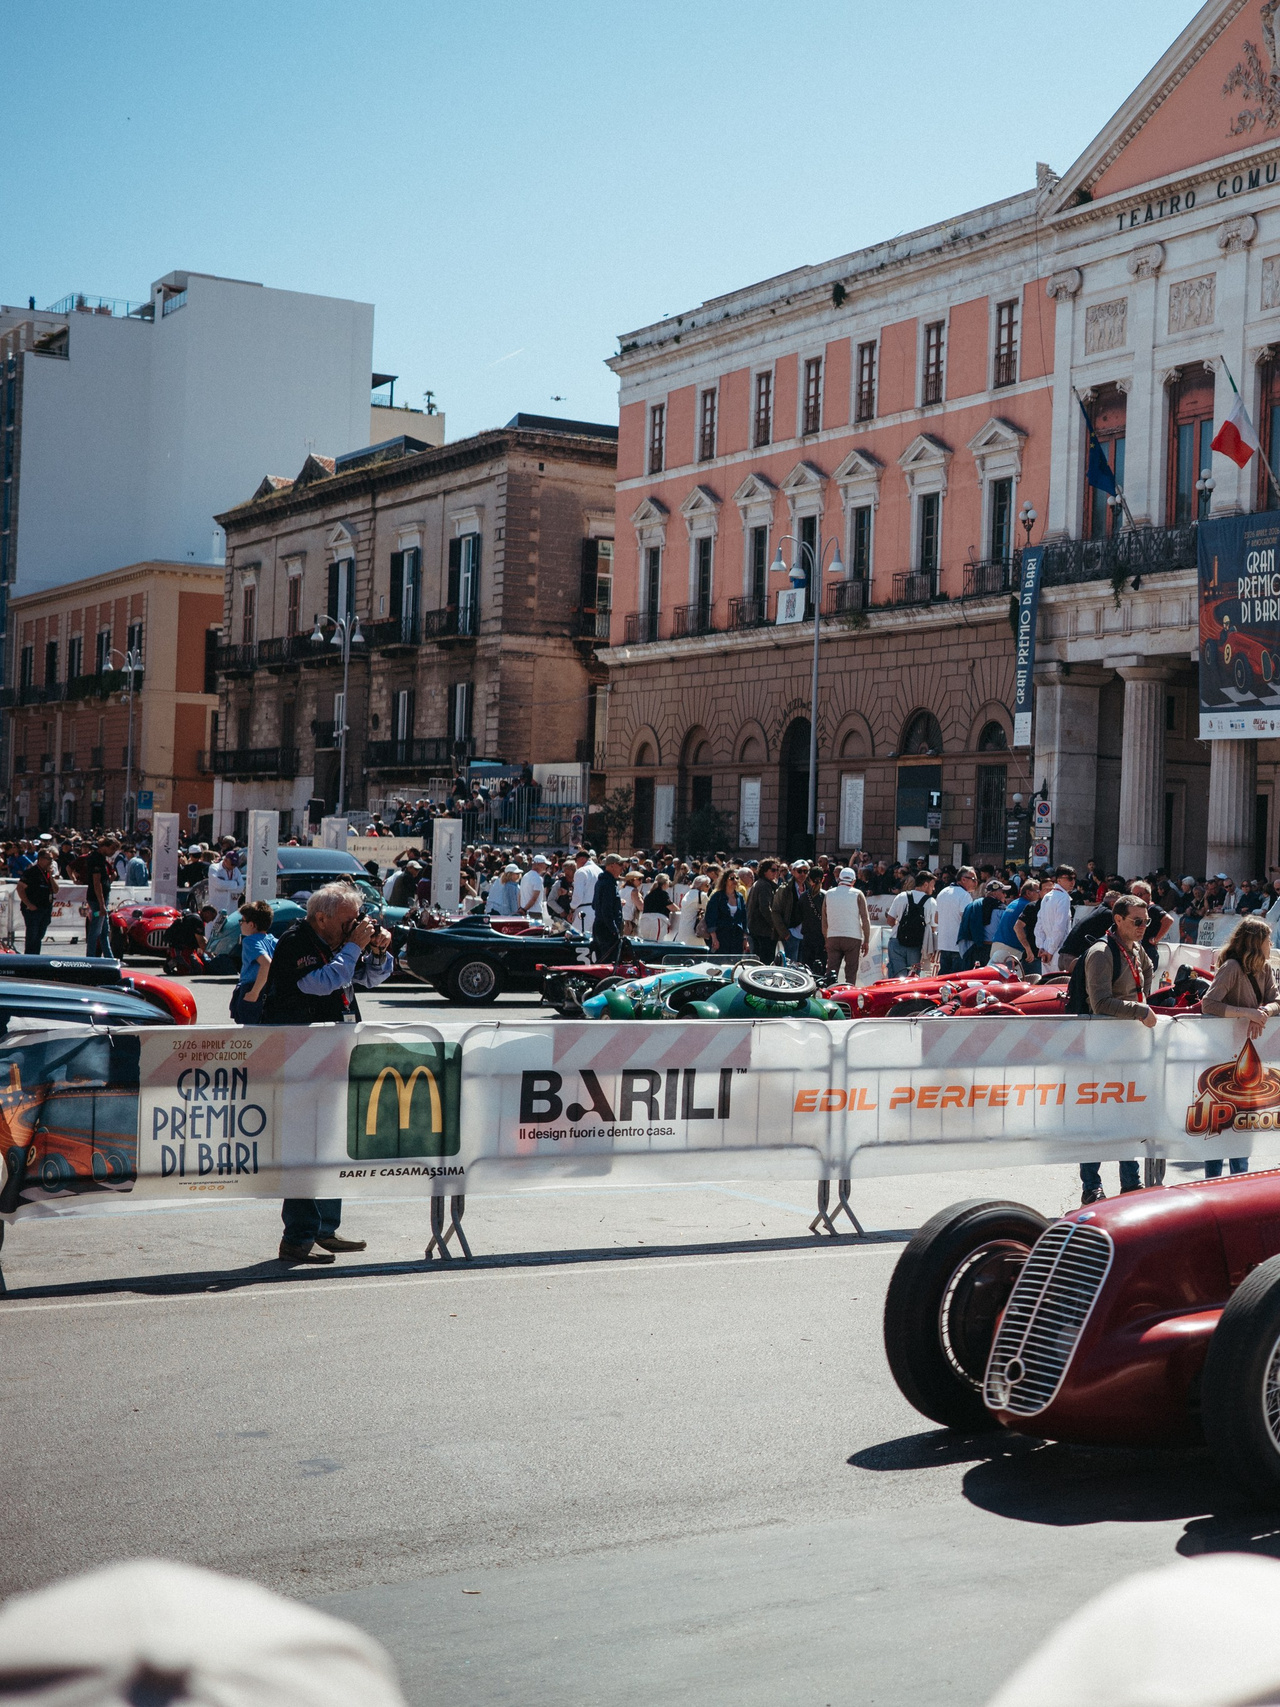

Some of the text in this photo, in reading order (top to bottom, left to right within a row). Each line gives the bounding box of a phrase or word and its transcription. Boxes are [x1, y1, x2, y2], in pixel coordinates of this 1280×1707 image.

[1116, 190, 1196, 231] TEATRO
[1025, 558, 1037, 588] BARI
[1247, 549, 1275, 574] GRAN
[1023, 592, 1032, 605] DI
[1241, 598, 1280, 623] DI BARI
[1018, 610, 1031, 665] PREMIO
[1017, 670, 1027, 704] GRAN
[930, 791, 941, 806] T
[172, 1039, 253, 1050] 23/26 APRILE 2026
[191, 1051, 247, 1061] RIEVOCAZIONE
[176, 1067, 248, 1101] GRAN
[519, 1067, 733, 1124] BARILI
[793, 1081, 1148, 1112] EDIL PERFETTI SRL
[153, 1104, 267, 1140] PREMIO
[528, 1128, 567, 1141] design
[569, 1126, 596, 1138] fuori
[597, 1129, 605, 1138] e
[606, 1126, 645, 1137] dentro
[646, 1127, 676, 1137] casa.
[1186, 1102, 1236, 1138] UP
[29, 1149, 35, 1161] 9
[161, 1142, 259, 1178] DI BARI
[339, 1166, 465, 1178] BARI E CASAMASSIMA
